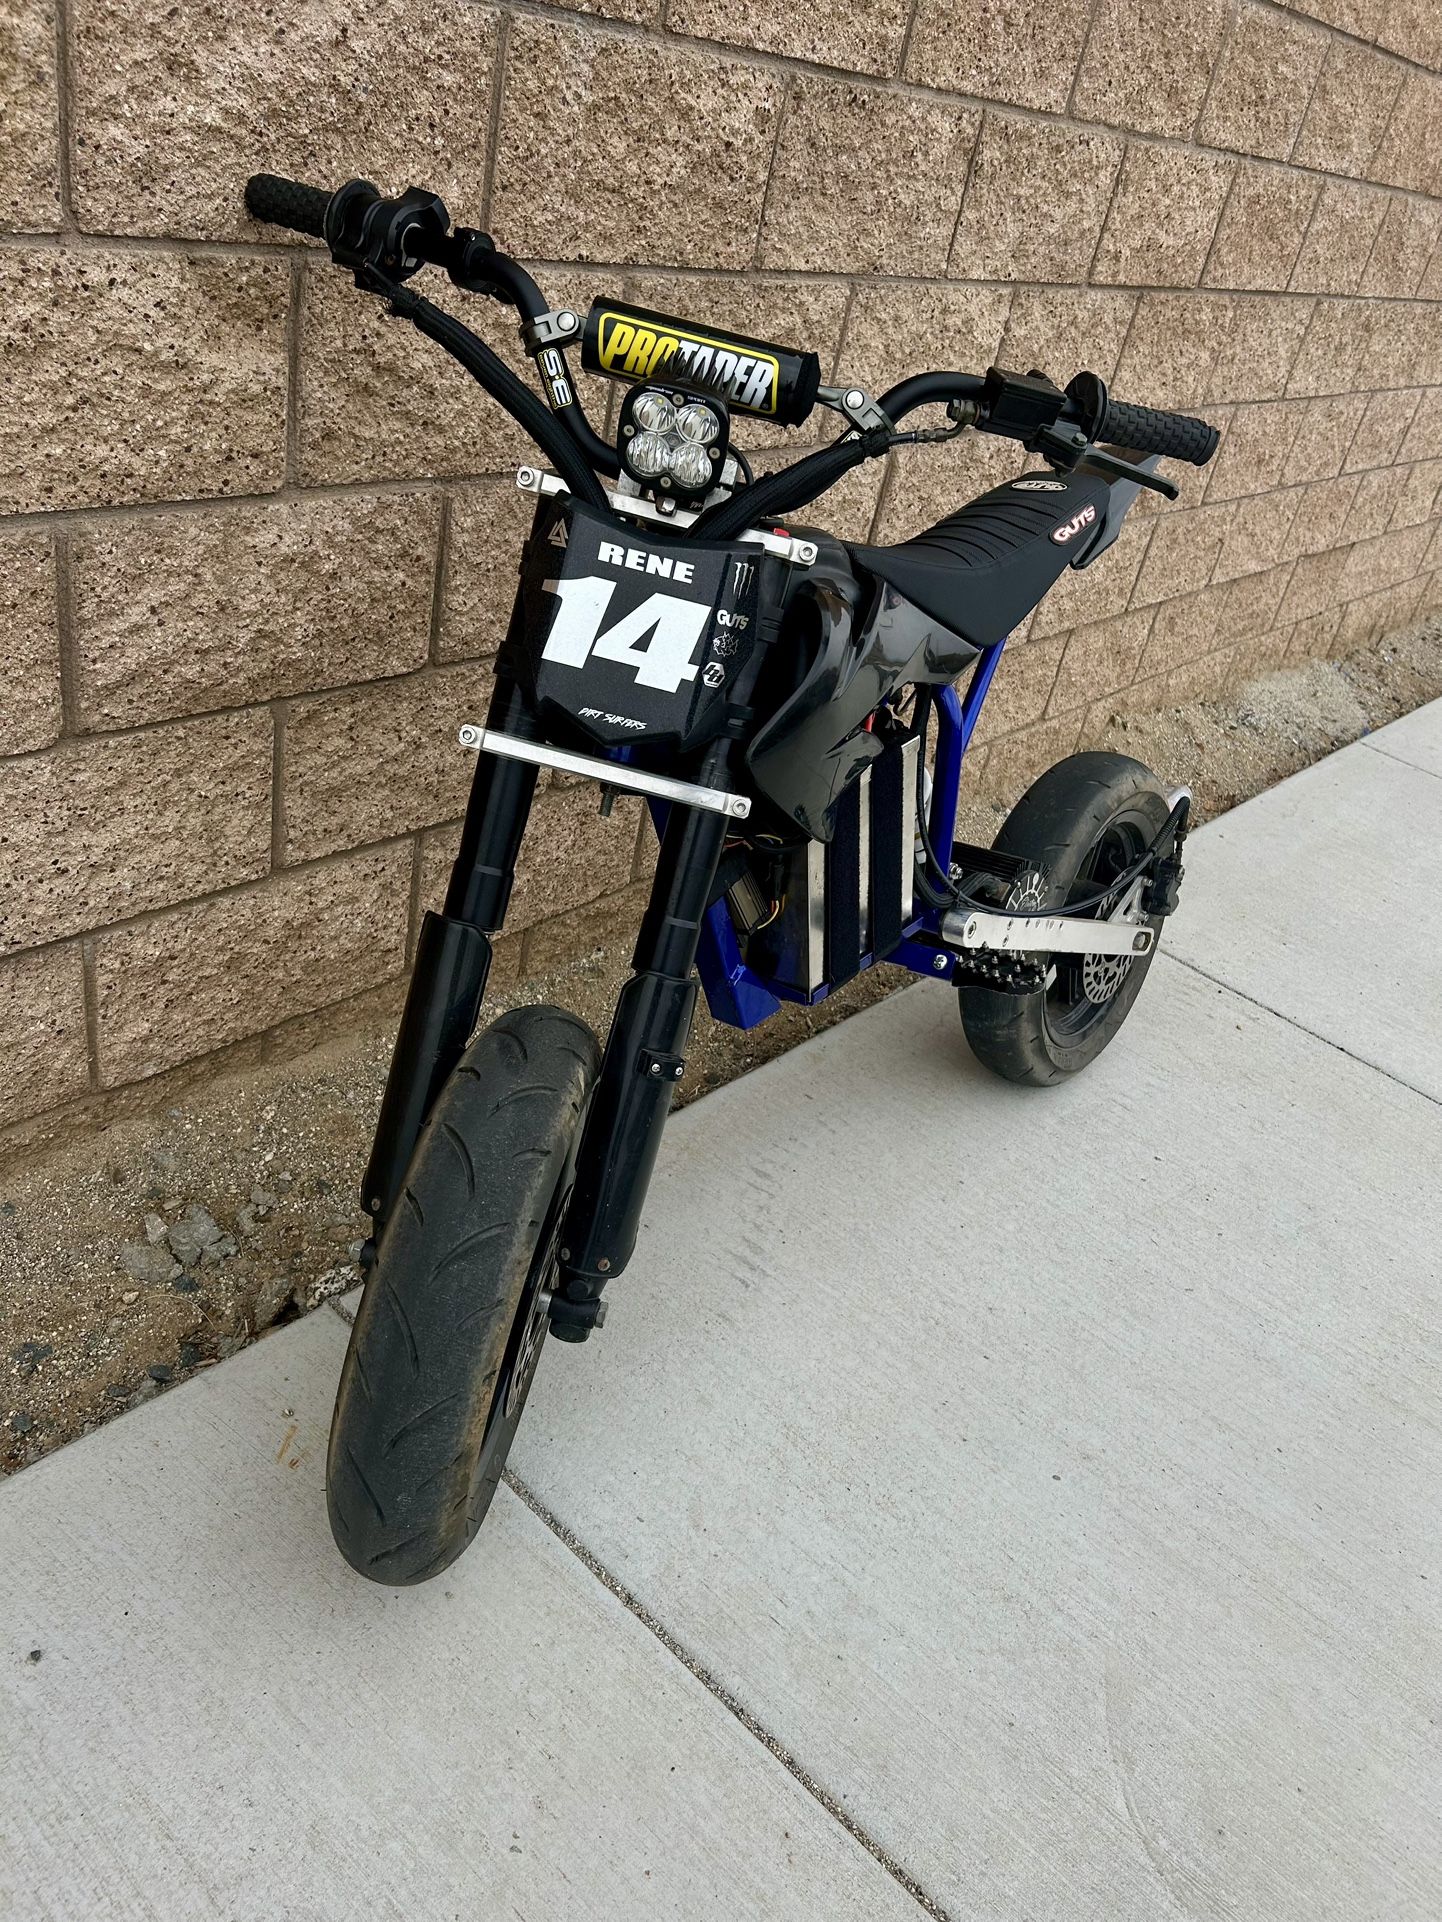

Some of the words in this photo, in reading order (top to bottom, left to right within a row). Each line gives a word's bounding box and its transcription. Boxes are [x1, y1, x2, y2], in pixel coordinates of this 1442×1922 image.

[1053, 505, 1096, 541] GUTS
[598, 541, 695, 584] RENE
[541, 575, 712, 694] 14
[716, 609, 749, 630] GUTS
[577, 707, 604, 719] DIRT
